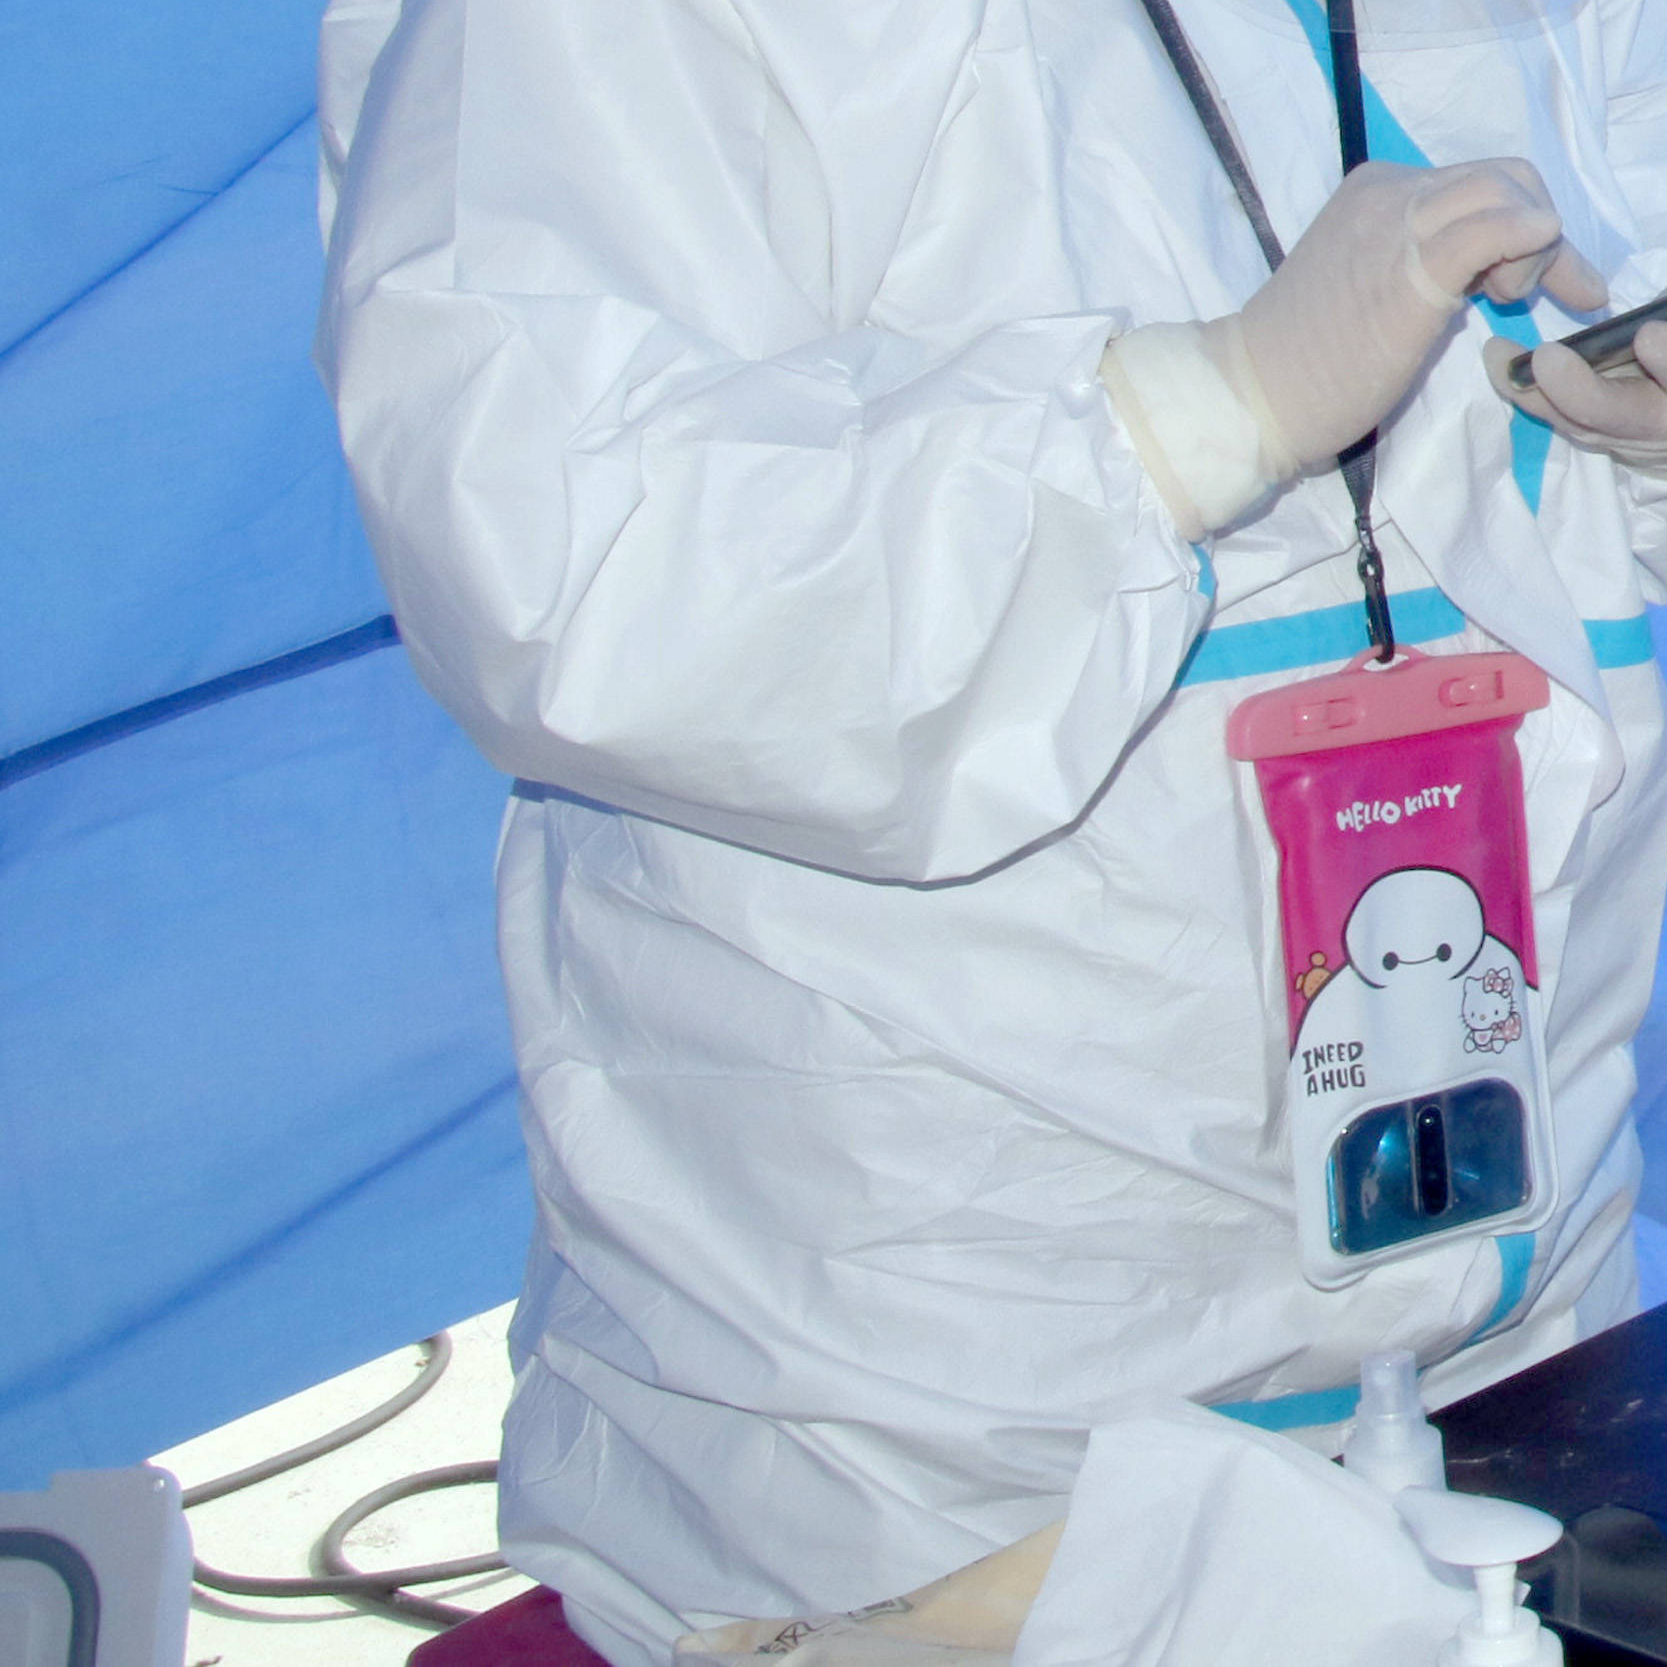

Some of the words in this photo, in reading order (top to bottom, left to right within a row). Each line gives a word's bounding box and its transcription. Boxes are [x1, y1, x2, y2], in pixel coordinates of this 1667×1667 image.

[1336, 800, 1401, 832] HELLO
[1404, 783, 1463, 816] KITTY
[1313, 1041, 1364, 1068] NEED
[1321, 1064, 1366, 1092] HUG
